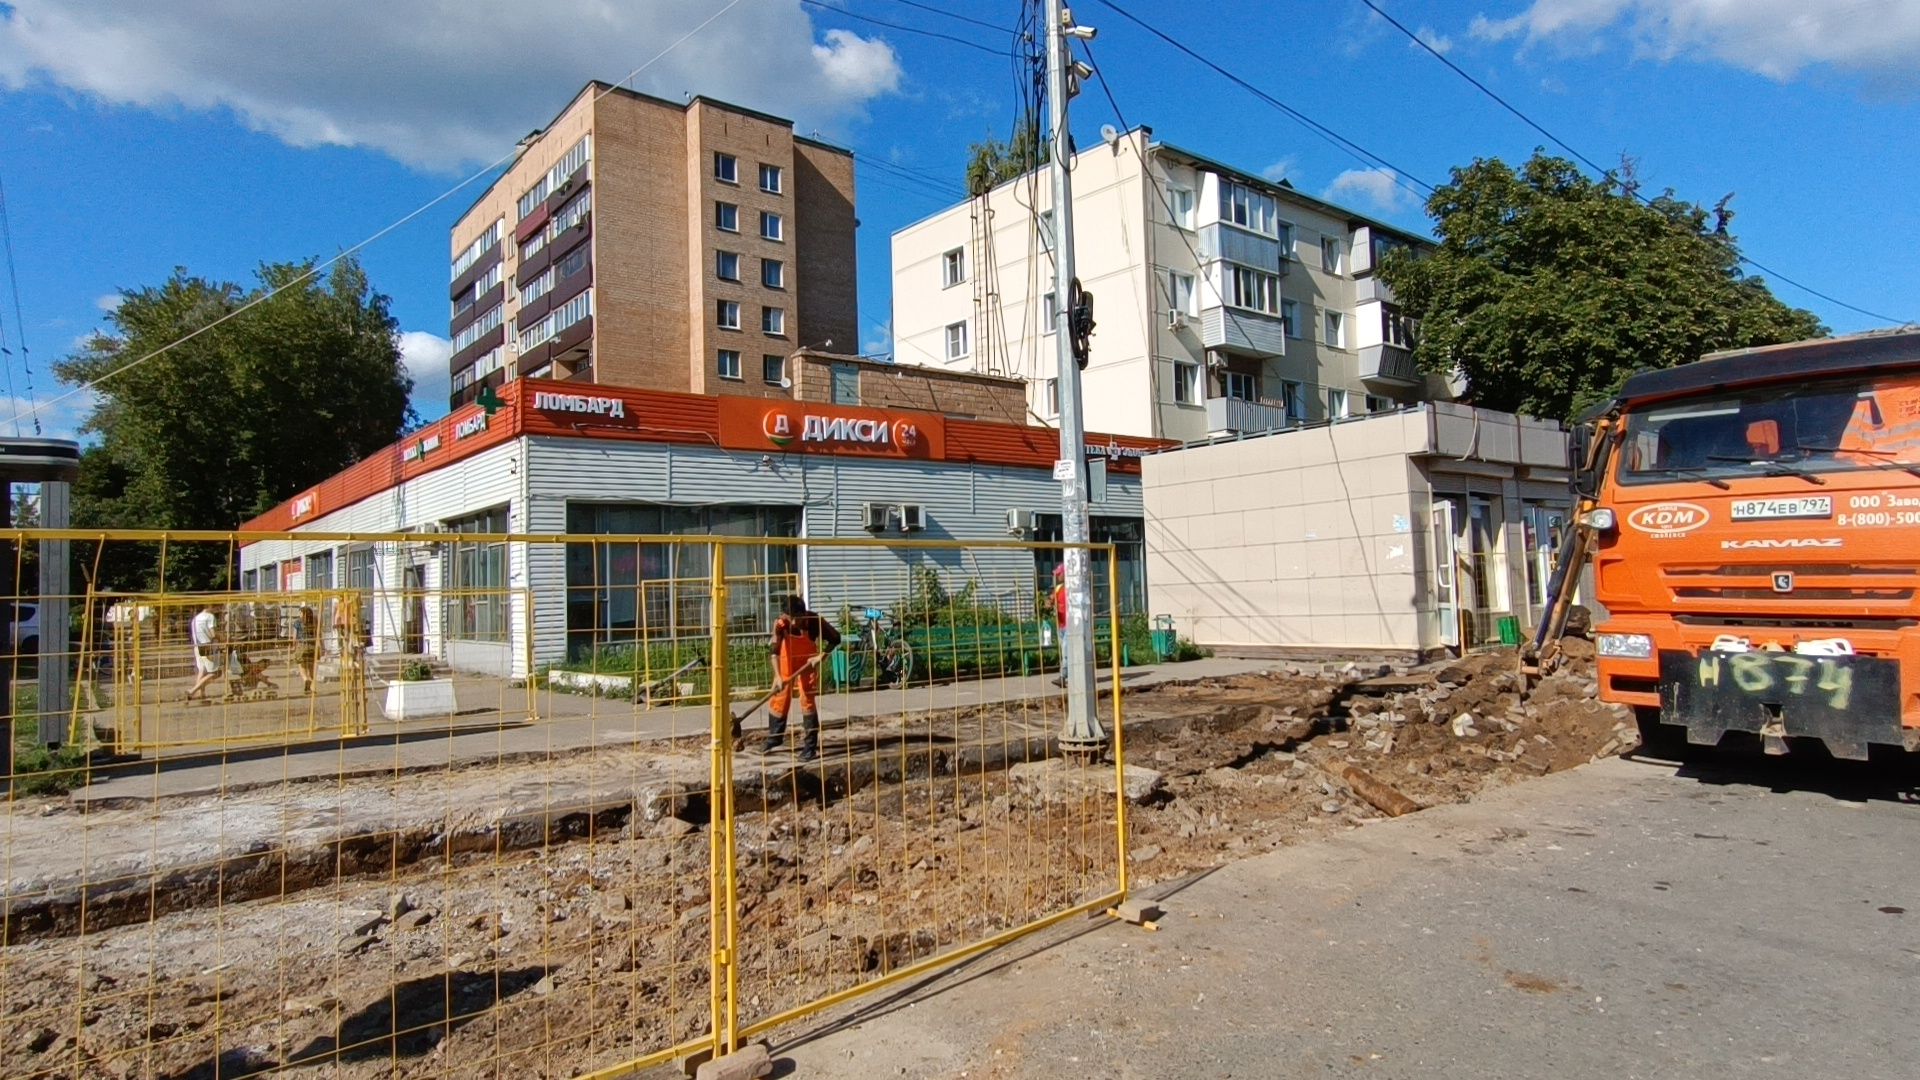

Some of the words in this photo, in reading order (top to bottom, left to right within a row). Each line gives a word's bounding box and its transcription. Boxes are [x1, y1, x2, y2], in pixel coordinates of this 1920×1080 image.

[533, 391, 624, 418] ЛОМБАРД
[802, 414, 888, 443] ДИКСИ
[1801, 499, 1826, 509] 797
[1720, 538, 1843, 549] KAMAZ
